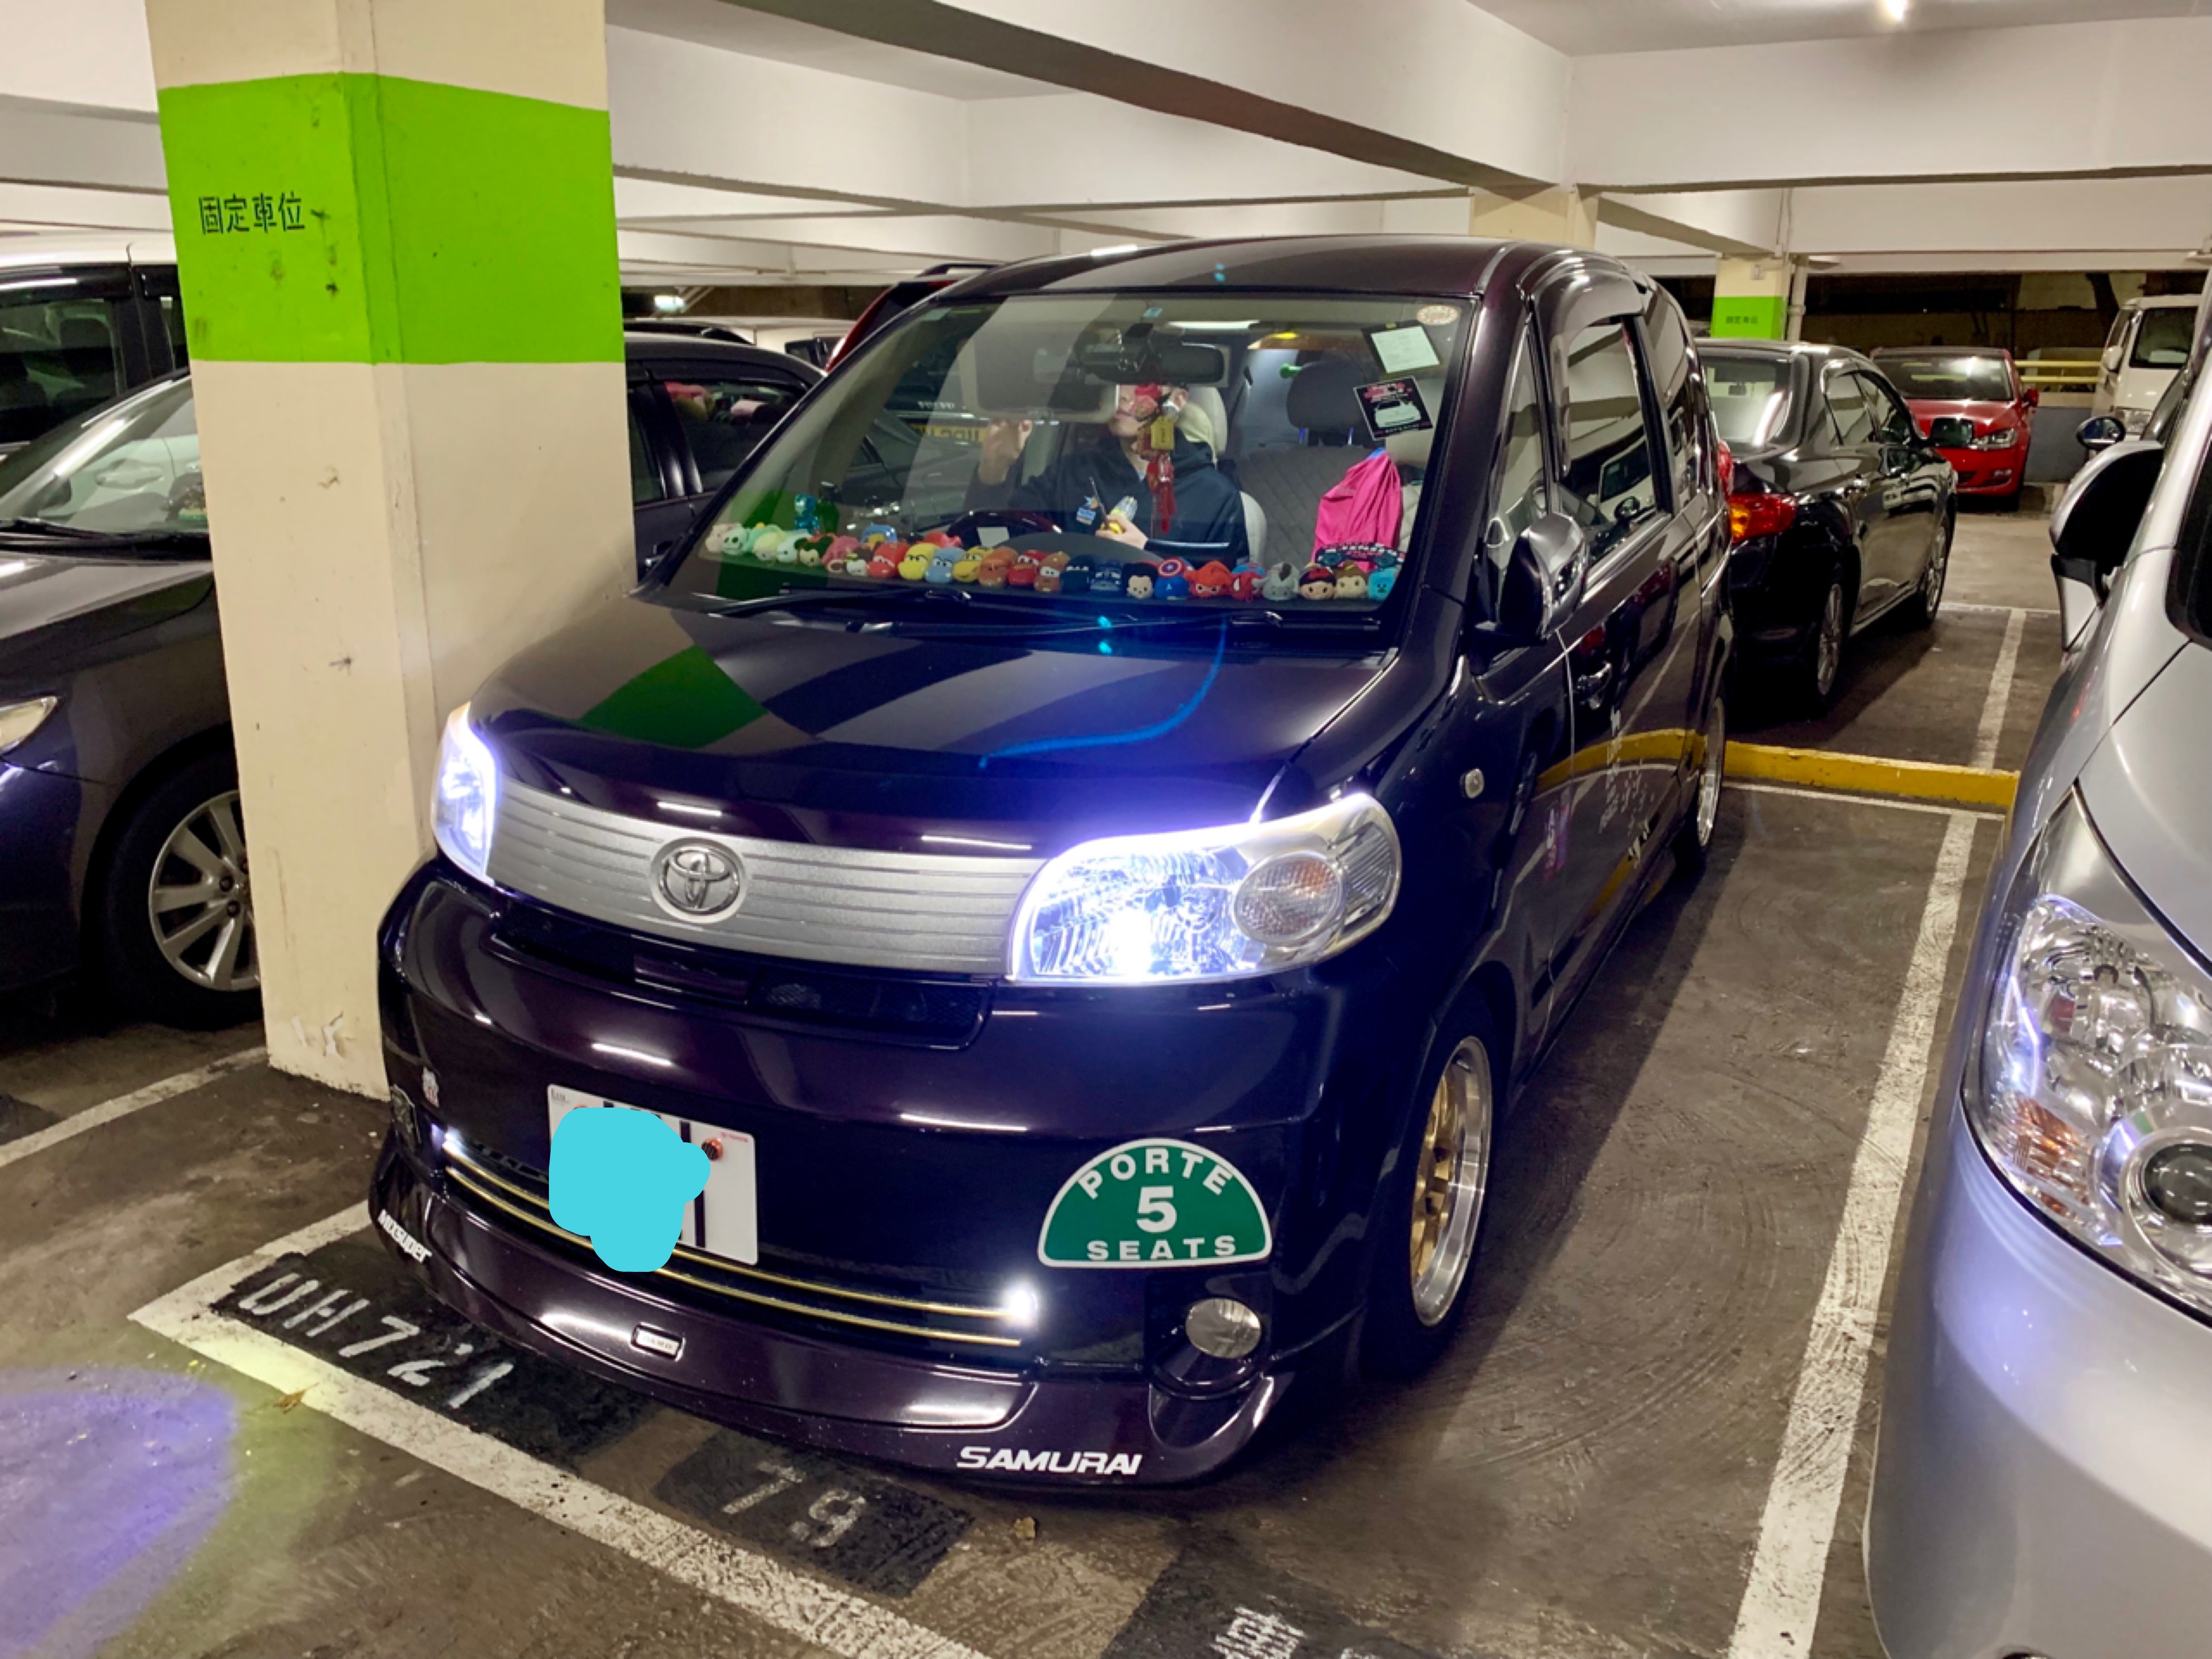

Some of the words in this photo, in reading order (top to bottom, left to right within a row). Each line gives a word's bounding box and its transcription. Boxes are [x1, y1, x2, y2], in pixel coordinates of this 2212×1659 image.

[199, 190, 306, 235] 固定車位
[1078, 1147, 1233, 1200] PORTE
[1136, 1185, 1177, 1233] 5
[1086, 1234, 1236, 1261] SEATS
[956, 1445, 1143, 1475] SAMURAI
[721, 1459, 867, 1548] 79
